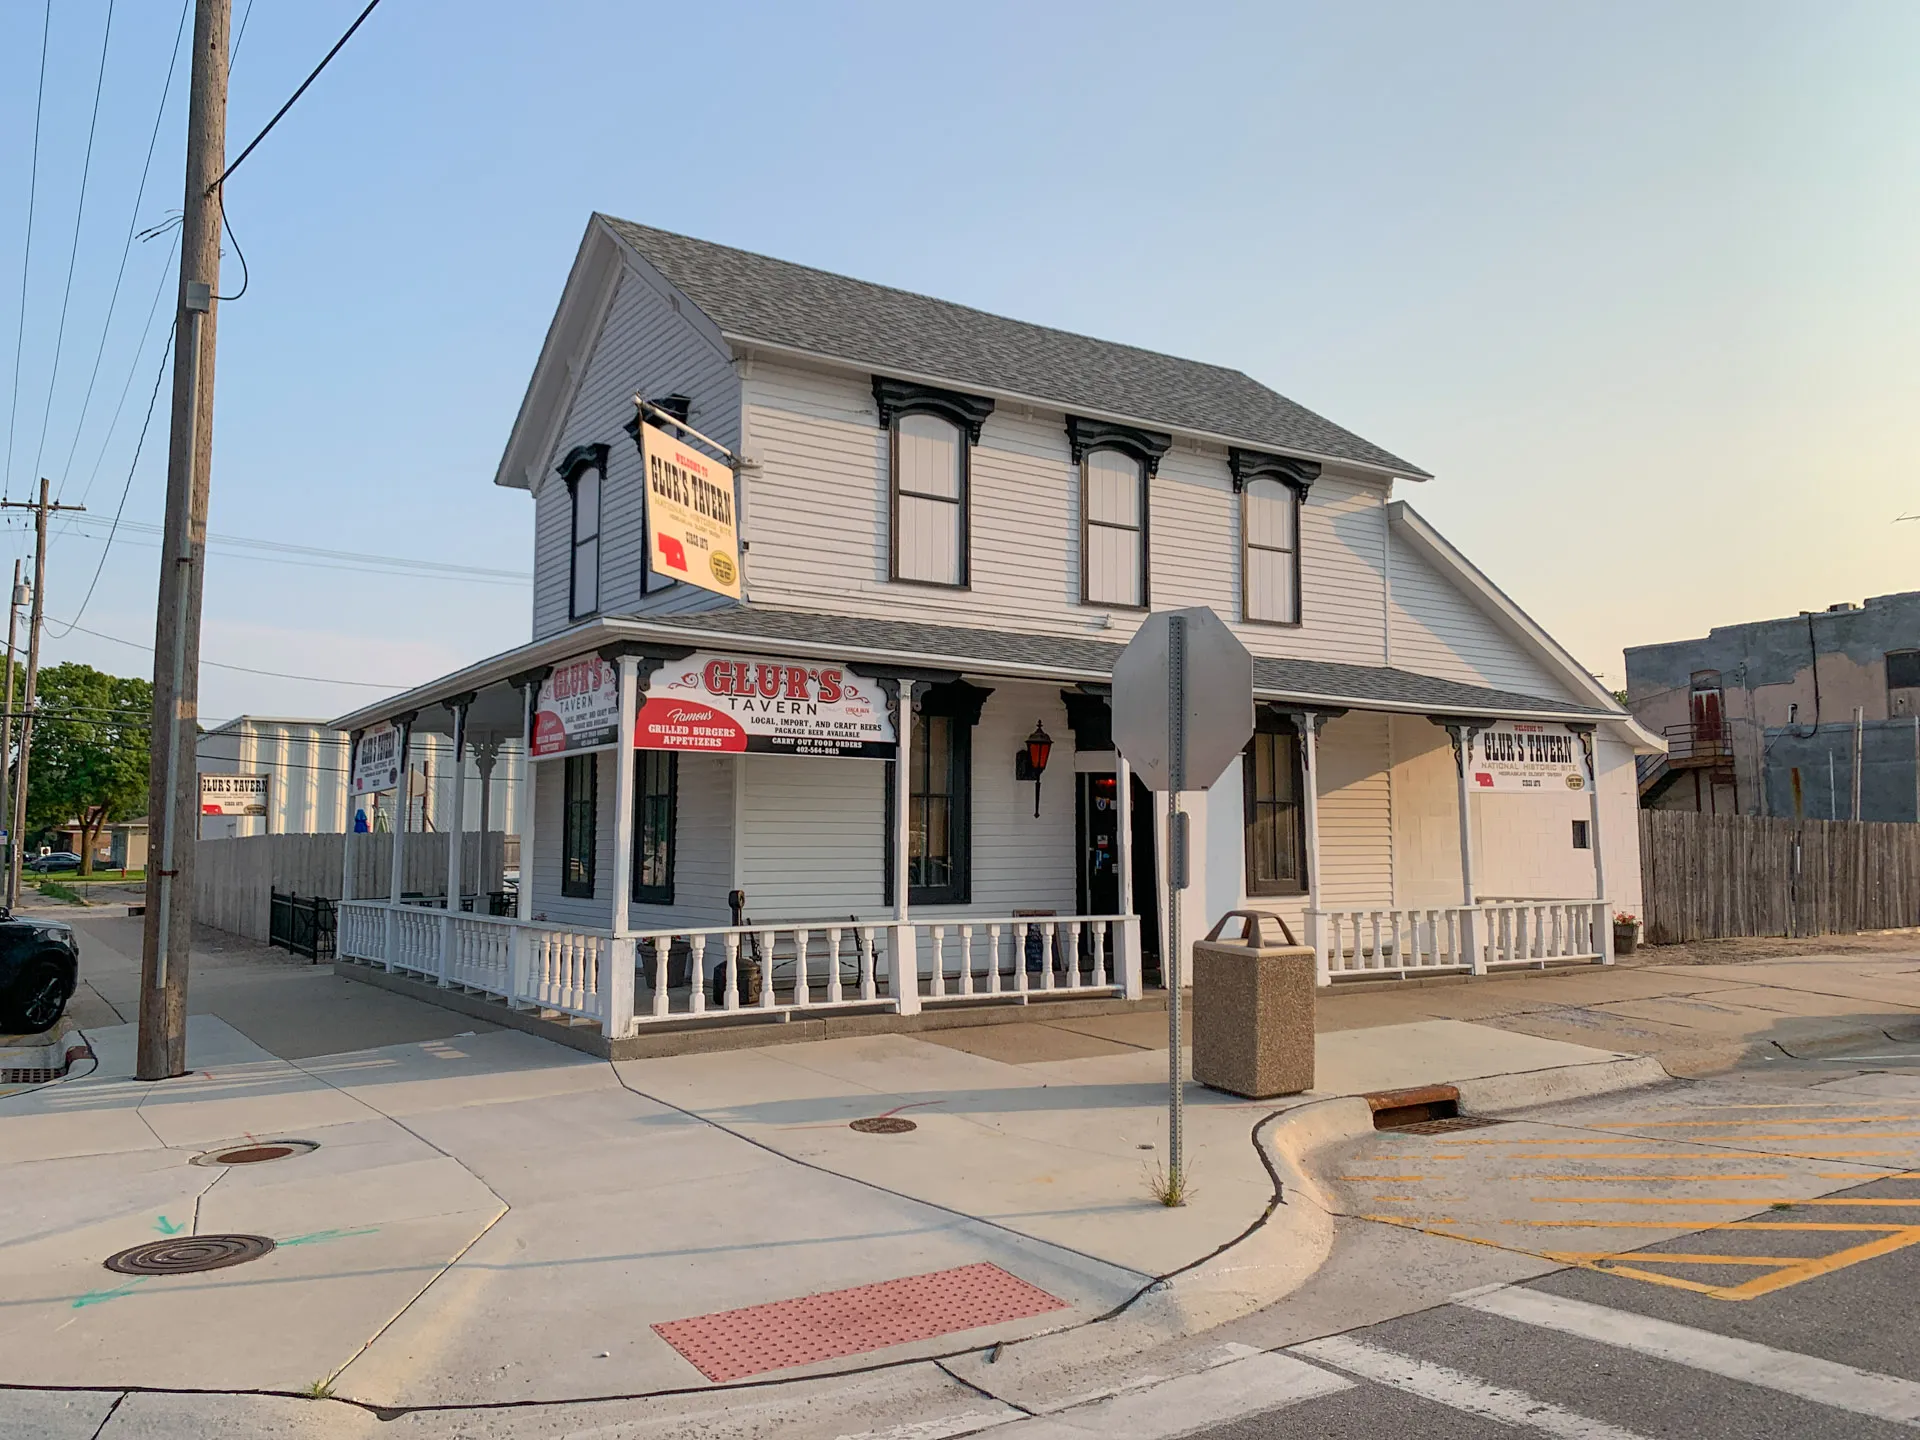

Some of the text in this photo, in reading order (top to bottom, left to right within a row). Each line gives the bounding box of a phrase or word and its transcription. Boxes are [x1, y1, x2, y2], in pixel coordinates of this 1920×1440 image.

[675, 452, 700, 473] WELCOME
[651, 454, 689, 507] GLUR'S
[691, 474, 732, 526] TAVERN
[554, 658, 602, 700] GLUR'S
[701, 658, 843, 703] GLUR'S
[560, 695, 593, 713] TAVERN
[729, 698, 818, 715] TAVERN
[667, 708, 714, 724] Famous
[751, 716, 882, 731] LOCAL, IMPORT, AND CRAFT BEERS
[648, 724, 735, 738] GRILLED BURGERS
[774, 727, 806, 735] PACKAGE
[826, 730, 860, 738] AVAILABLE
[663, 735, 722, 747] APPETIZERS
[772, 737, 862, 748] CARRY OUT FOOD ORDERS
[1484, 732, 1572, 763] GLUR'S TAVERN
[1481, 762, 1577, 772] NATIONAL HISTORIC SITE
[234, 779, 268, 793] TAVERN
